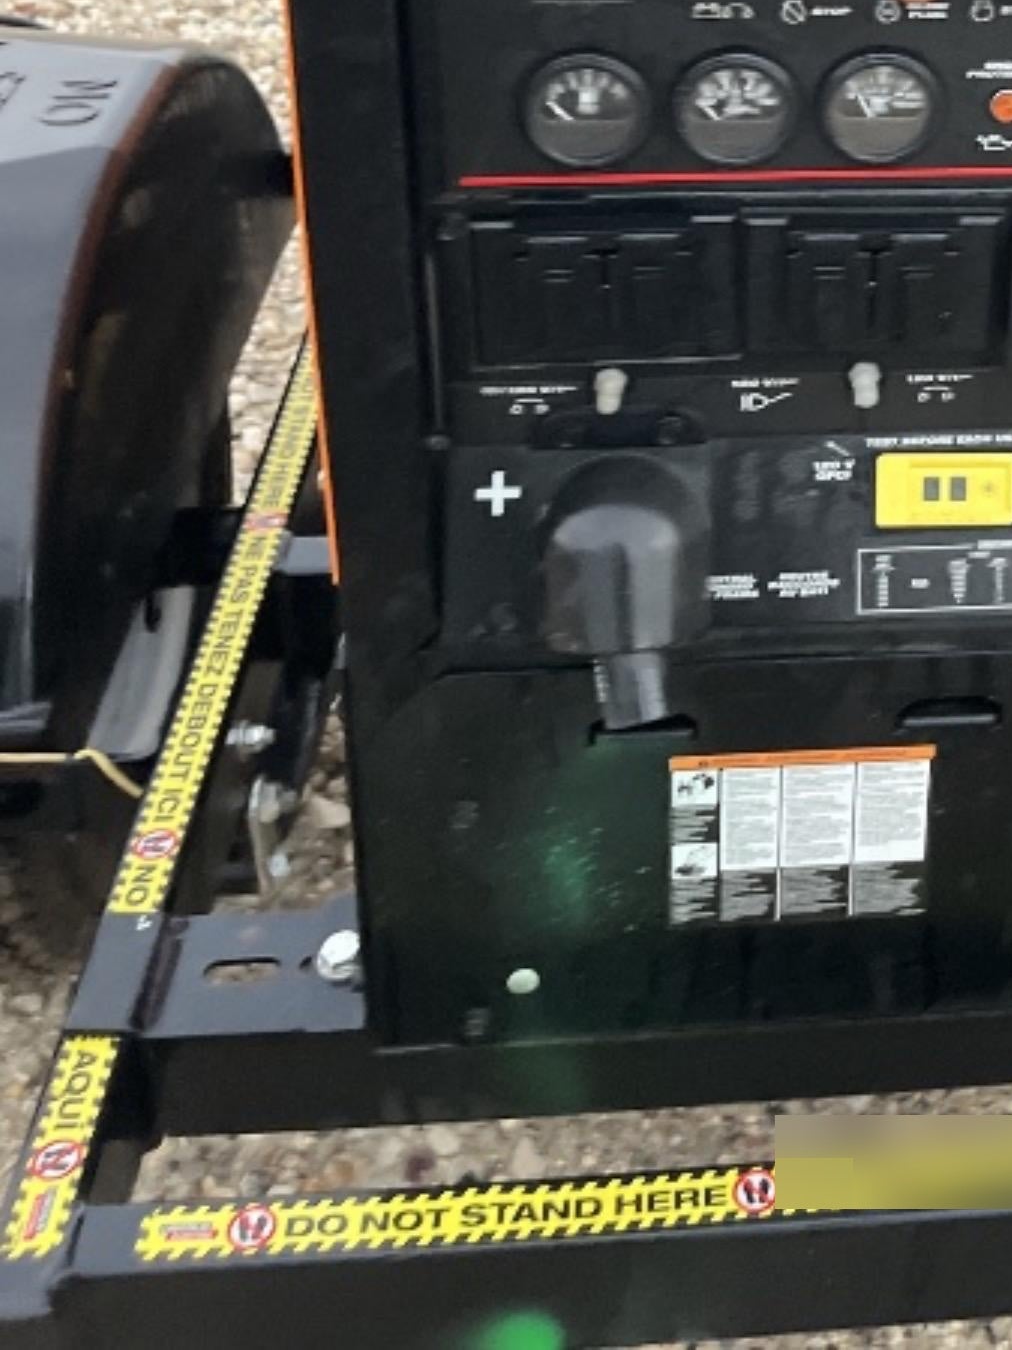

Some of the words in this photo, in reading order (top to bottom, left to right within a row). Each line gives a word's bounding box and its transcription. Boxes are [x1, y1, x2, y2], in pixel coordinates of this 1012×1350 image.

[228, 565, 258, 605] PAS
[153, 788, 183, 823] ICI
[125, 865, 156, 907] NO
[283, 1214, 350, 1238] DO
[359, 1207, 451, 1232] NOT
[459, 1195, 601, 1228] STAND
[614, 1187, 729, 1215] HERE
